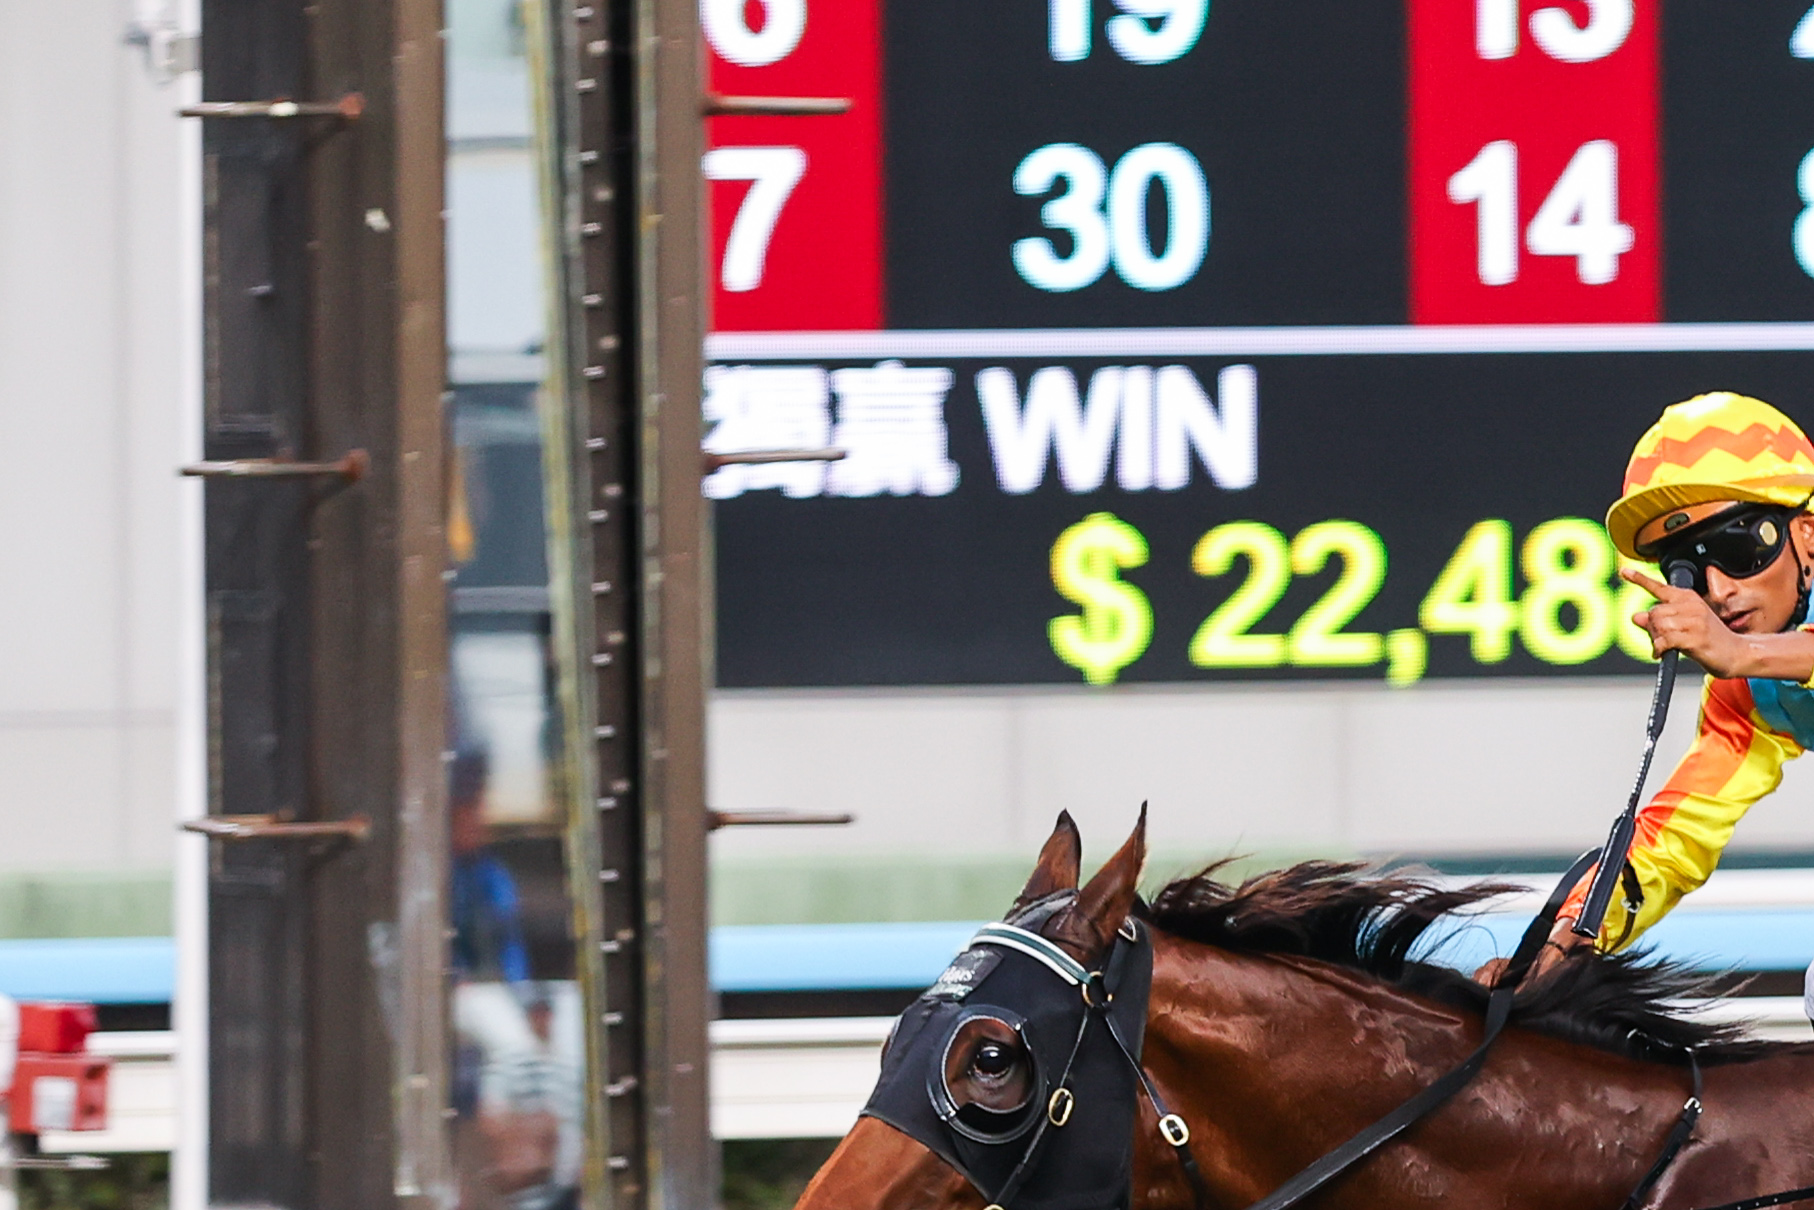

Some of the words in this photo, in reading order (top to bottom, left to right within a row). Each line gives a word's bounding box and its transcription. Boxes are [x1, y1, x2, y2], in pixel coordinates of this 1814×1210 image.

[700, 146, 808, 292] 7
[1010, 142, 1211, 293] 30
[1446, 139, 1635, 286] 14
[975, 364, 1258, 494] WIN
